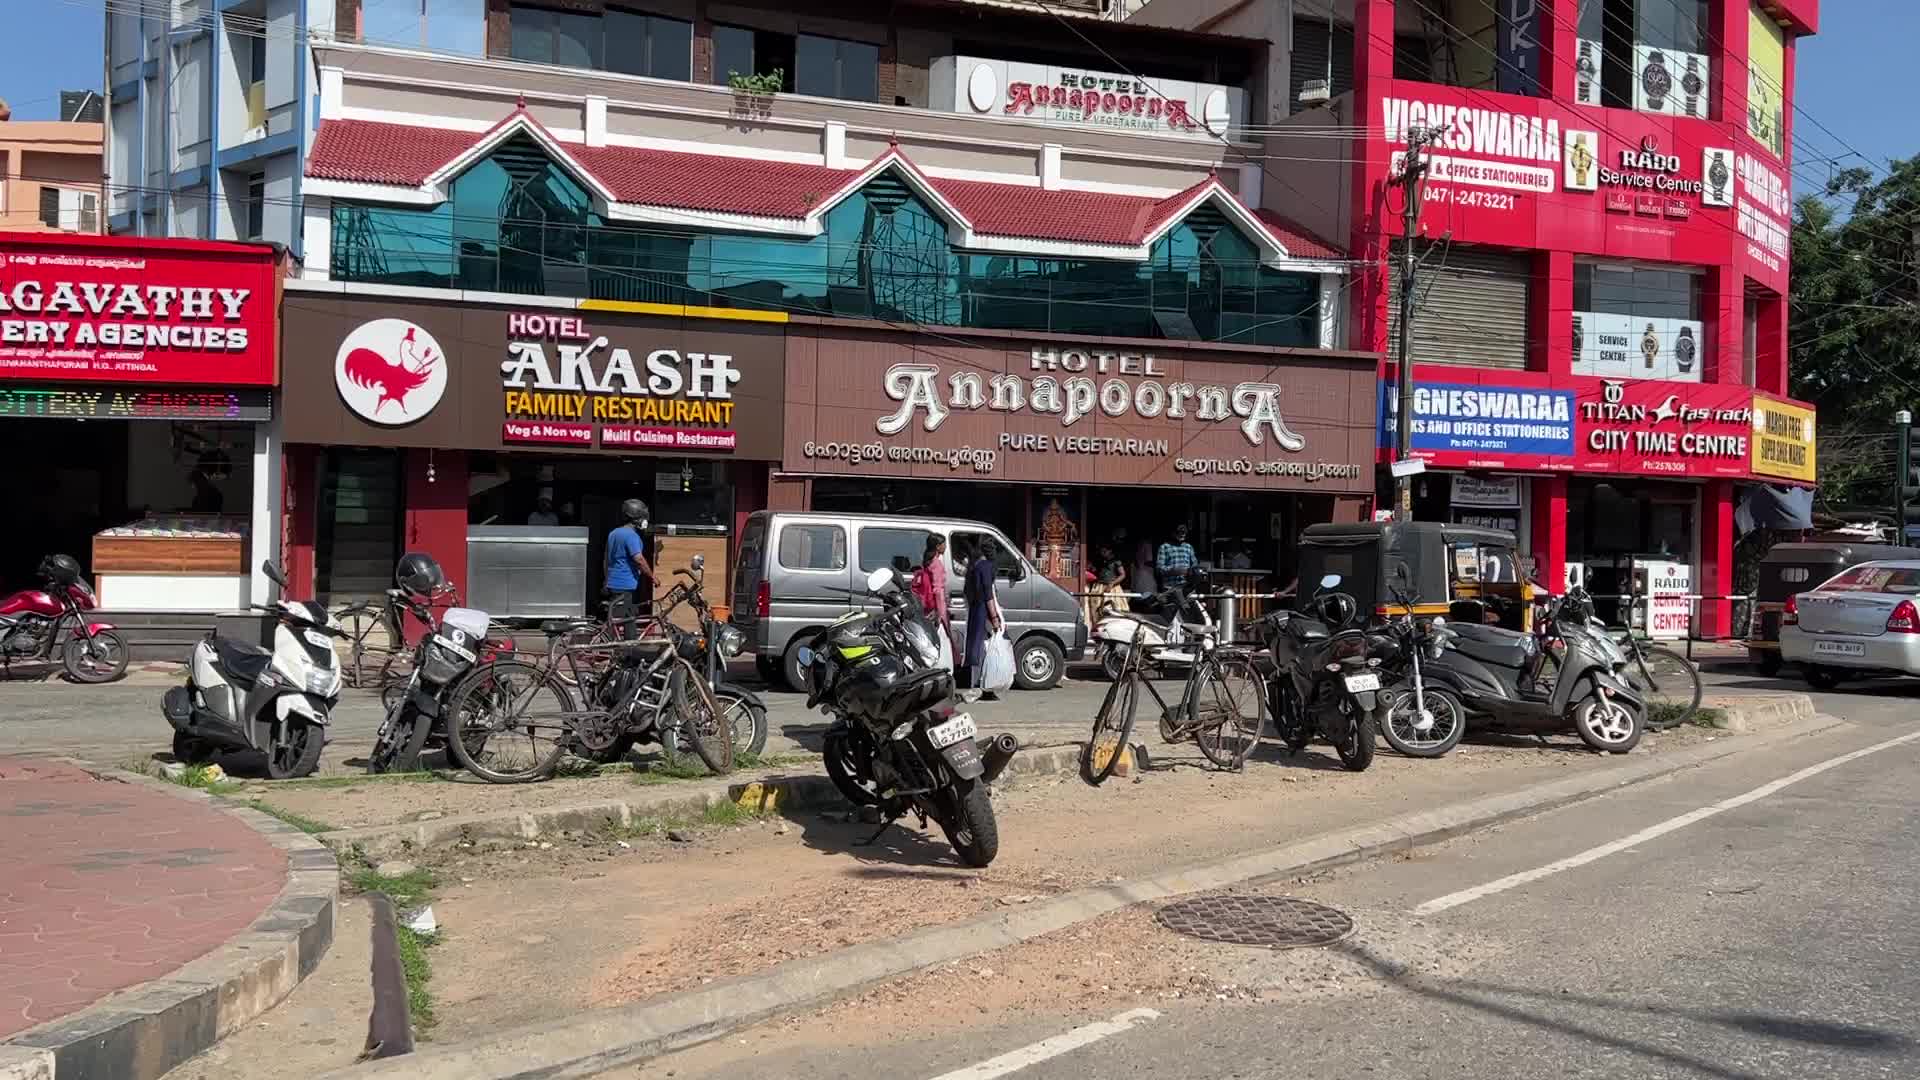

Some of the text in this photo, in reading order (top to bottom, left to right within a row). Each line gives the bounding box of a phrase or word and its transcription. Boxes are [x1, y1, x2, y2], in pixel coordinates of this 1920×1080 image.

[1060, 72, 1148, 95] HOTEL
[1056, 111, 1154, 130] PURE VEGETARIAN
[1622, 149, 1681, 172] RADO
[1436, 162, 1444, 175] &
[1446, 164, 1480, 180] OFFICE
[1482, 167, 1549, 187] STATIONERIES
[1600, 168, 1702, 193] Service Centre
[1424, 187, 1514, 210] 0471-2473221
[75, 322, 249, 349] AGENCIES
[509, 314, 590, 338] HOTEL
[1599, 335, 1628, 347] SERVICE
[501, 336, 741, 398] AKASH
[1031, 346, 1165, 377] HOTEL
[1600, 351, 1626, 362] CENTRE
[505, 391, 735, 424] FAMILY RESTAURANT
[1582, 402, 1646, 420] TITAN
[507, 424, 591, 441] Veg & Non veg
[602, 429, 735, 447] Multi Cuisine Restaurant
[1427, 421, 1450, 435] AND
[1454, 422, 1491, 437] OFFICE
[1494, 424, 1570, 440] STATIONERIES
[1000, 433, 1168, 456] PURE VEGETARIAN
[1590, 429, 1746, 456] CITY TIME CENTRE
[1654, 577, 1690, 589] RADO
[1654, 592, 1690, 607] SERVICE
[1654, 613, 1690, 630] CENTRE
